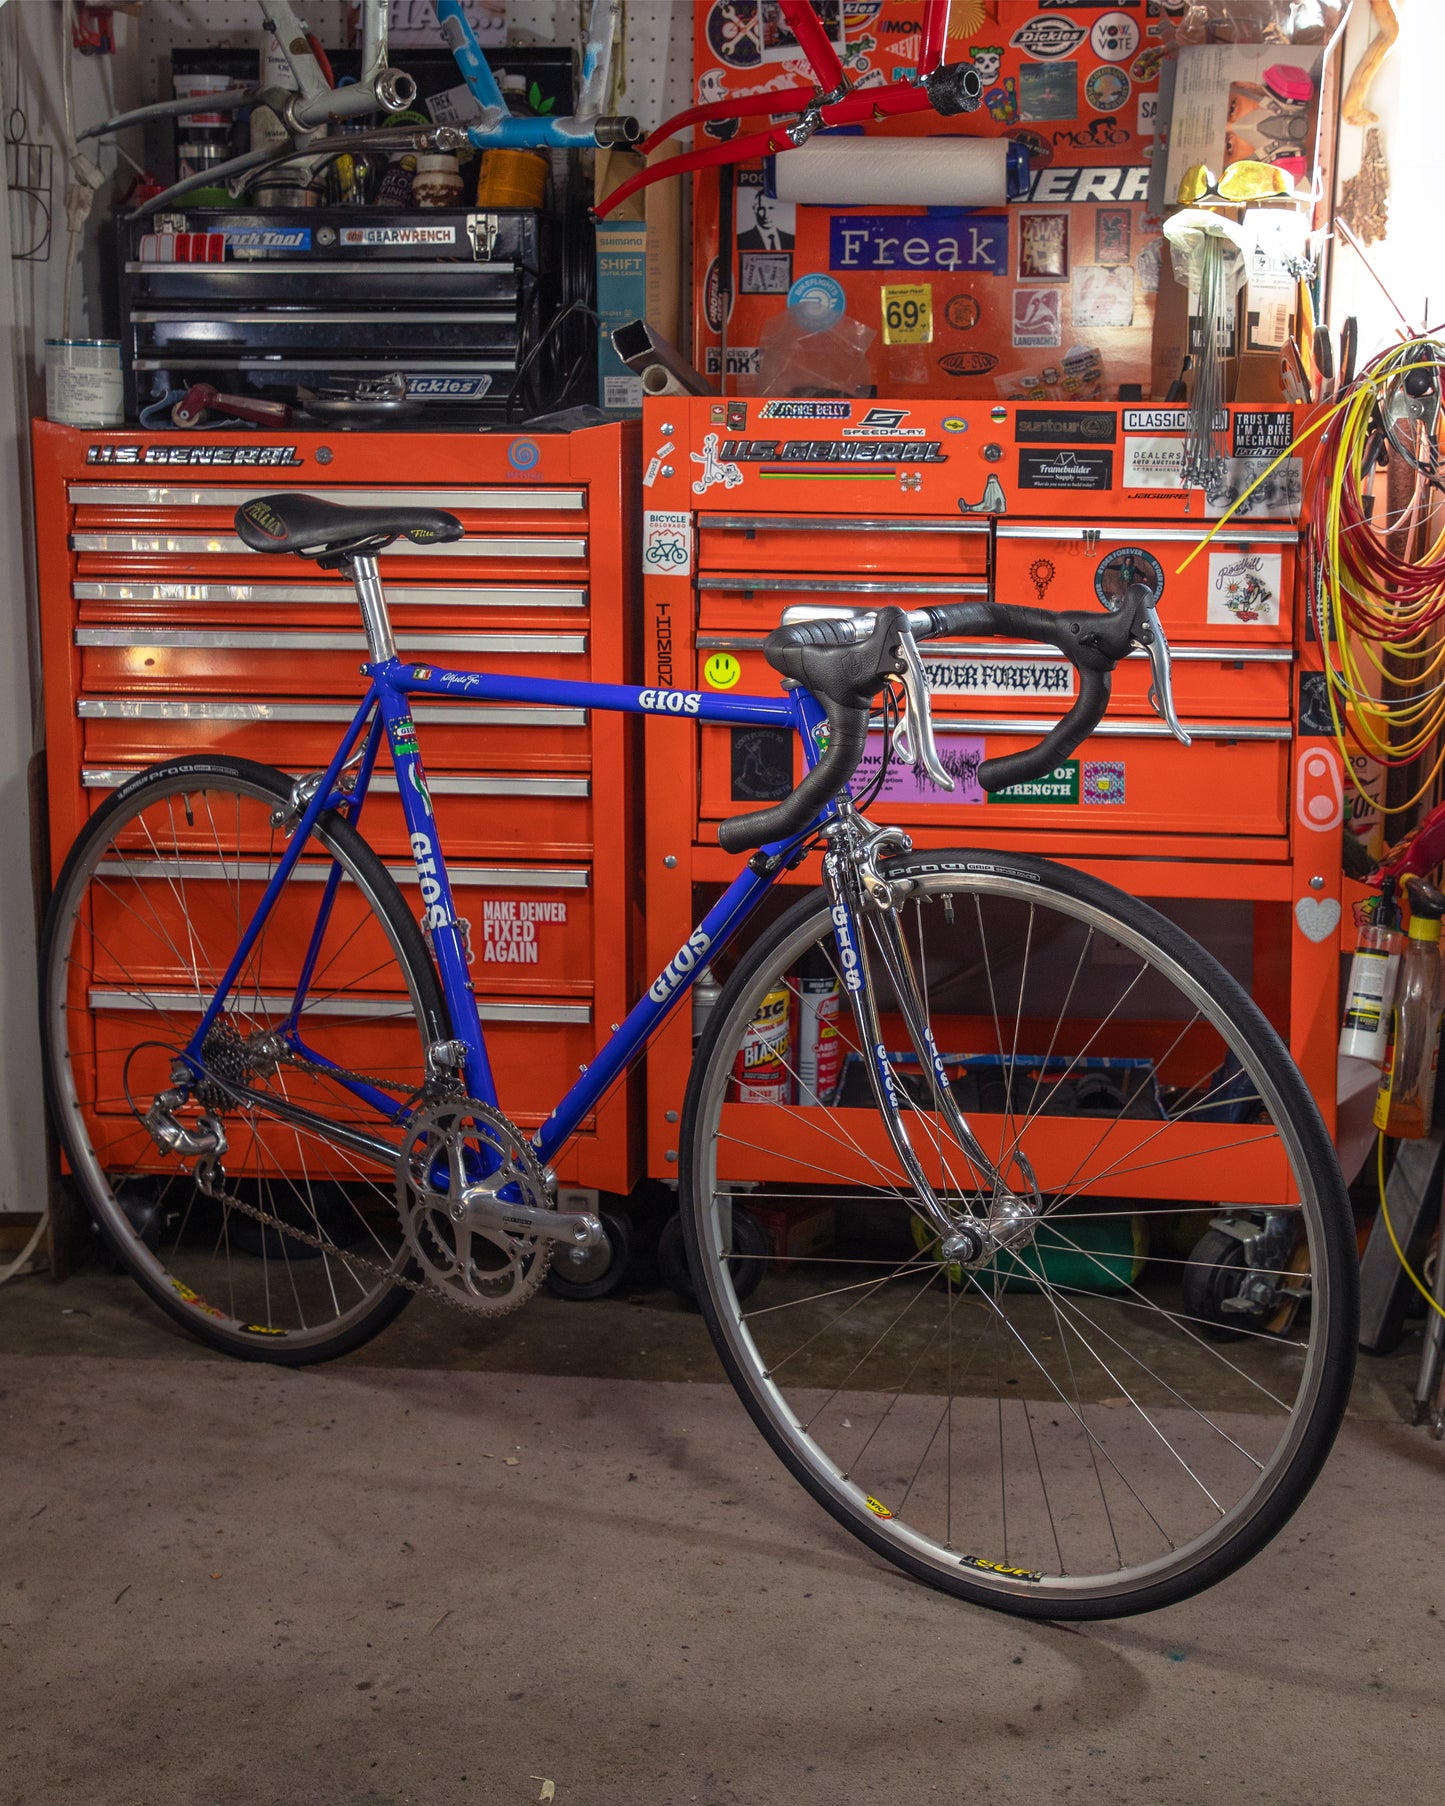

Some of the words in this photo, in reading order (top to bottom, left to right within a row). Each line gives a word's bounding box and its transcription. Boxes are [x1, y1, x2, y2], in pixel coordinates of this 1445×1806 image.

[1019, 30, 1079, 42] Dickies
[1099, 38, 1132, 50] VOTE
[1053, 131, 1130, 146] MOJO
[224, 232, 259, 246] ark
[259, 232, 303, 246] Tool
[368, 230, 451, 242] GEARWRENCH
[600, 238, 642, 246] SHIMANO
[840, 228, 996, 266] Freak
[600, 258, 642, 270] SHIFT
[408, 379, 473, 394] ickies
[778, 404, 814, 416] SNAKE
[815, 403, 846, 416] BELLY
[1019, 419, 1080, 433] suntour
[1129, 413, 1186, 428] CLASSIC
[1237, 414, 1268, 425] TRUST
[1277, 414, 1291, 425] ME
[1237, 425, 1251, 435] I'M
[1257, 425, 1263, 435] A
[1268, 425, 1291, 435] BIKE
[1236, 436, 1292, 446] MECHANIC
[86, 445, 141, 465] U.S.
[144, 446, 303, 466] GENERAL
[720, 440, 780, 461] U.S.
[781, 441, 948, 463] GENERAL
[1040, 464, 1091, 474] Framebuilder
[650, 515, 686, 523] BICYCLE
[656, 603, 672, 686] THOMSON
[639, 689, 702, 714] GIOS
[400, 726, 415, 735] GIO
[1053, 768, 1076, 779] OF
[409, 832, 449, 931] GIOS
[484, 901, 516, 921] MAKE
[520, 902, 566, 922] DENVER
[484, 922, 535, 942] FIXED
[484, 942, 539, 964] AGAIN
[831, 905, 862, 991] GIOS
[649, 923, 711, 1003] GIOS
[924, 1027, 950, 1088] GIOS
[876, 1044, 899, 1108] GIOS
[867, 1498, 885, 1513] AVIC
